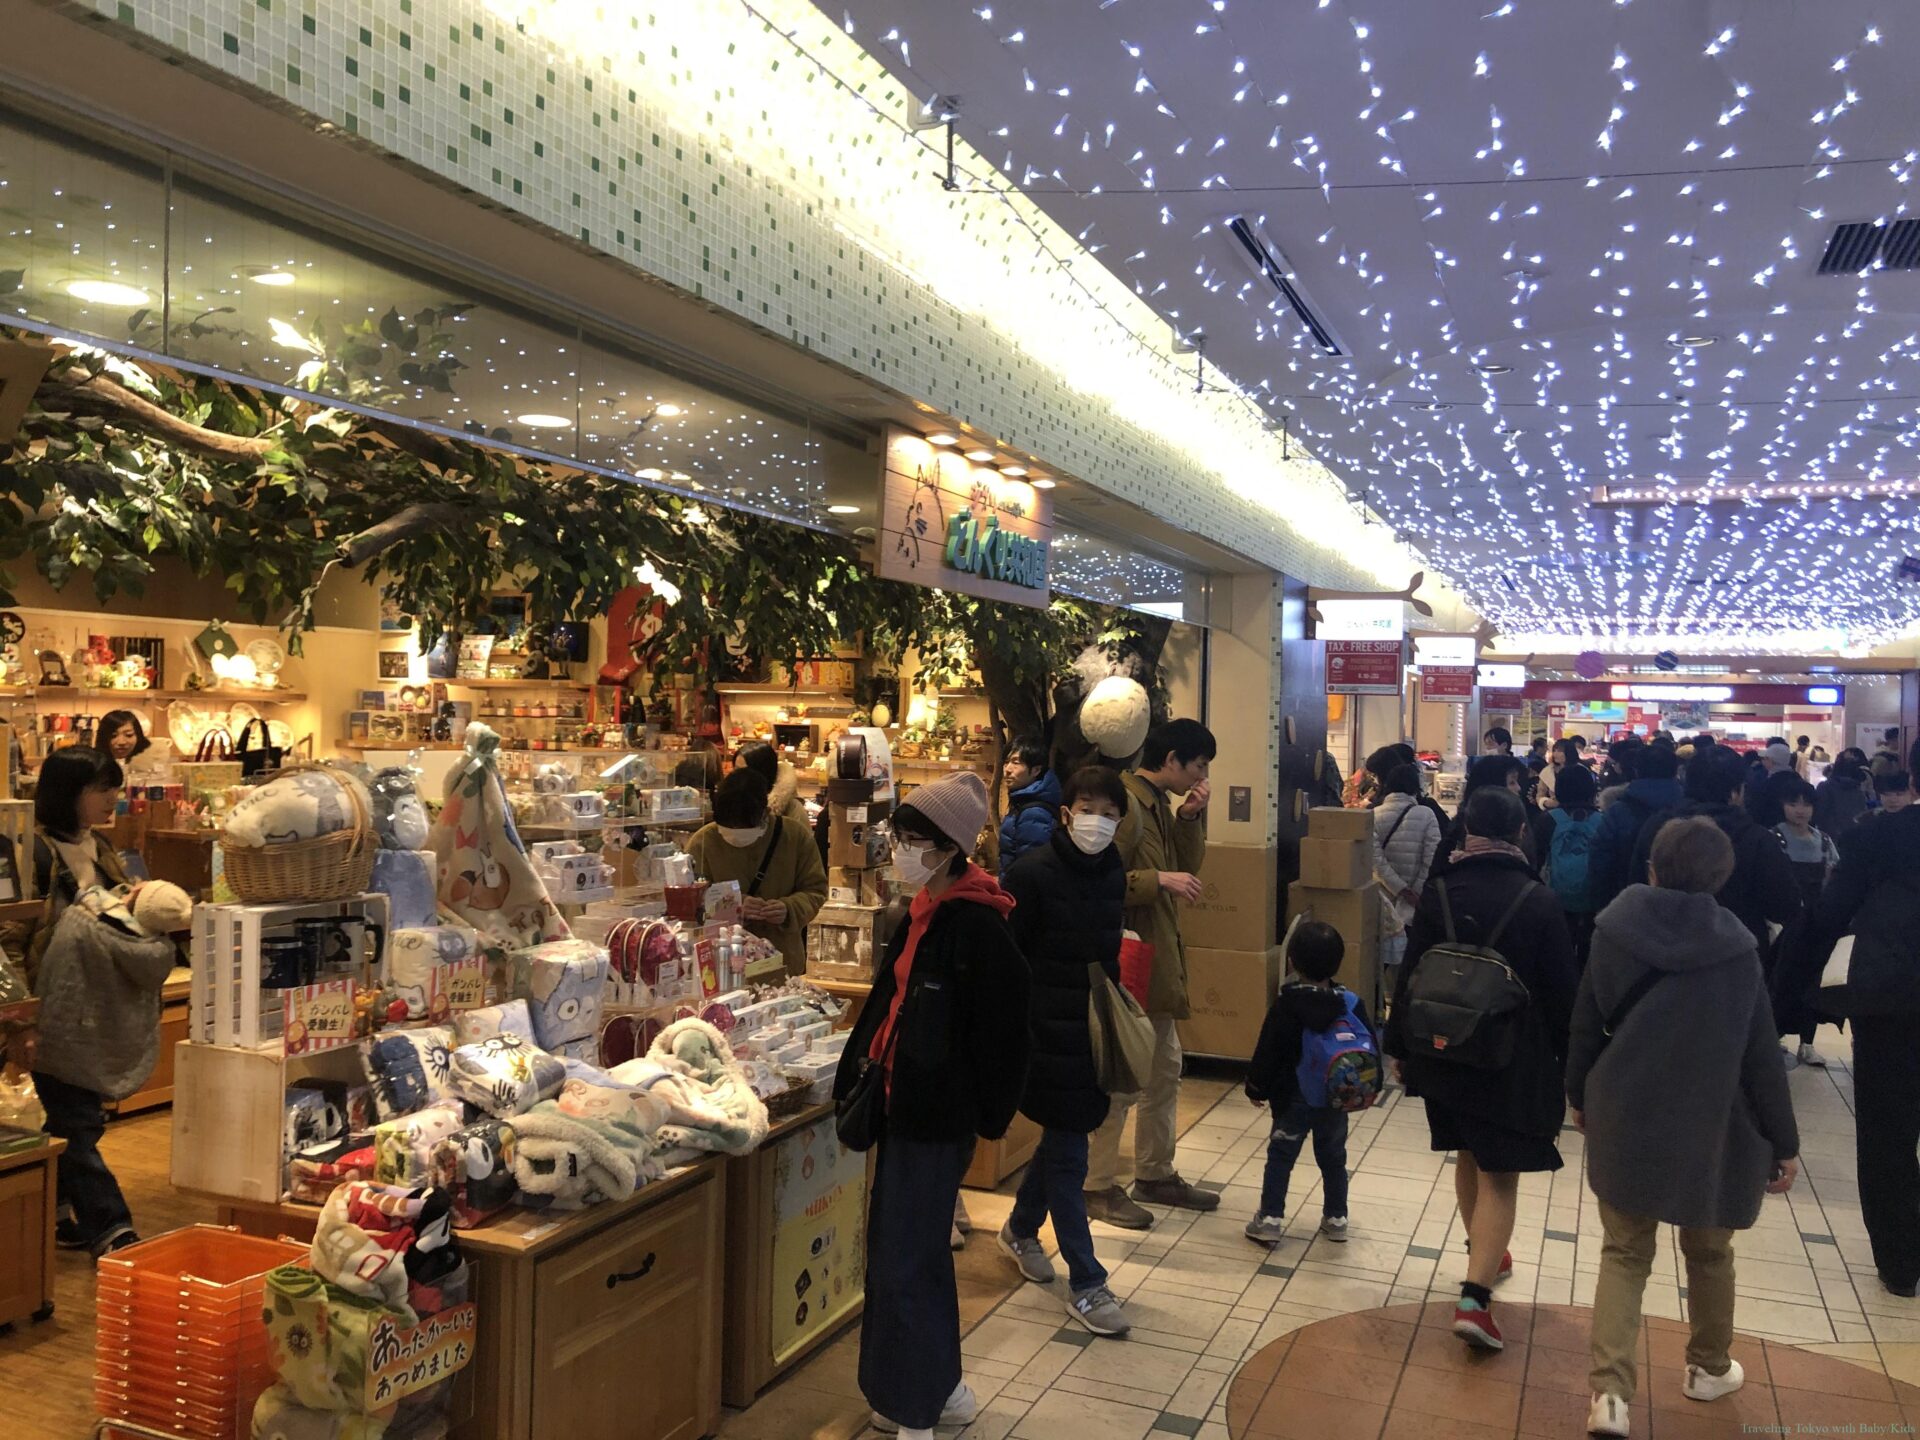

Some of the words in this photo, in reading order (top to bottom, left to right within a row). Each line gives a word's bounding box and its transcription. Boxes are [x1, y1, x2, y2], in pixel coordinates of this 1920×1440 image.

[1374, 642, 1399, 652] SHOP
[310, 1003, 350, 1016] ガンバレ
[375, 1341, 467, 1401] あつめました
